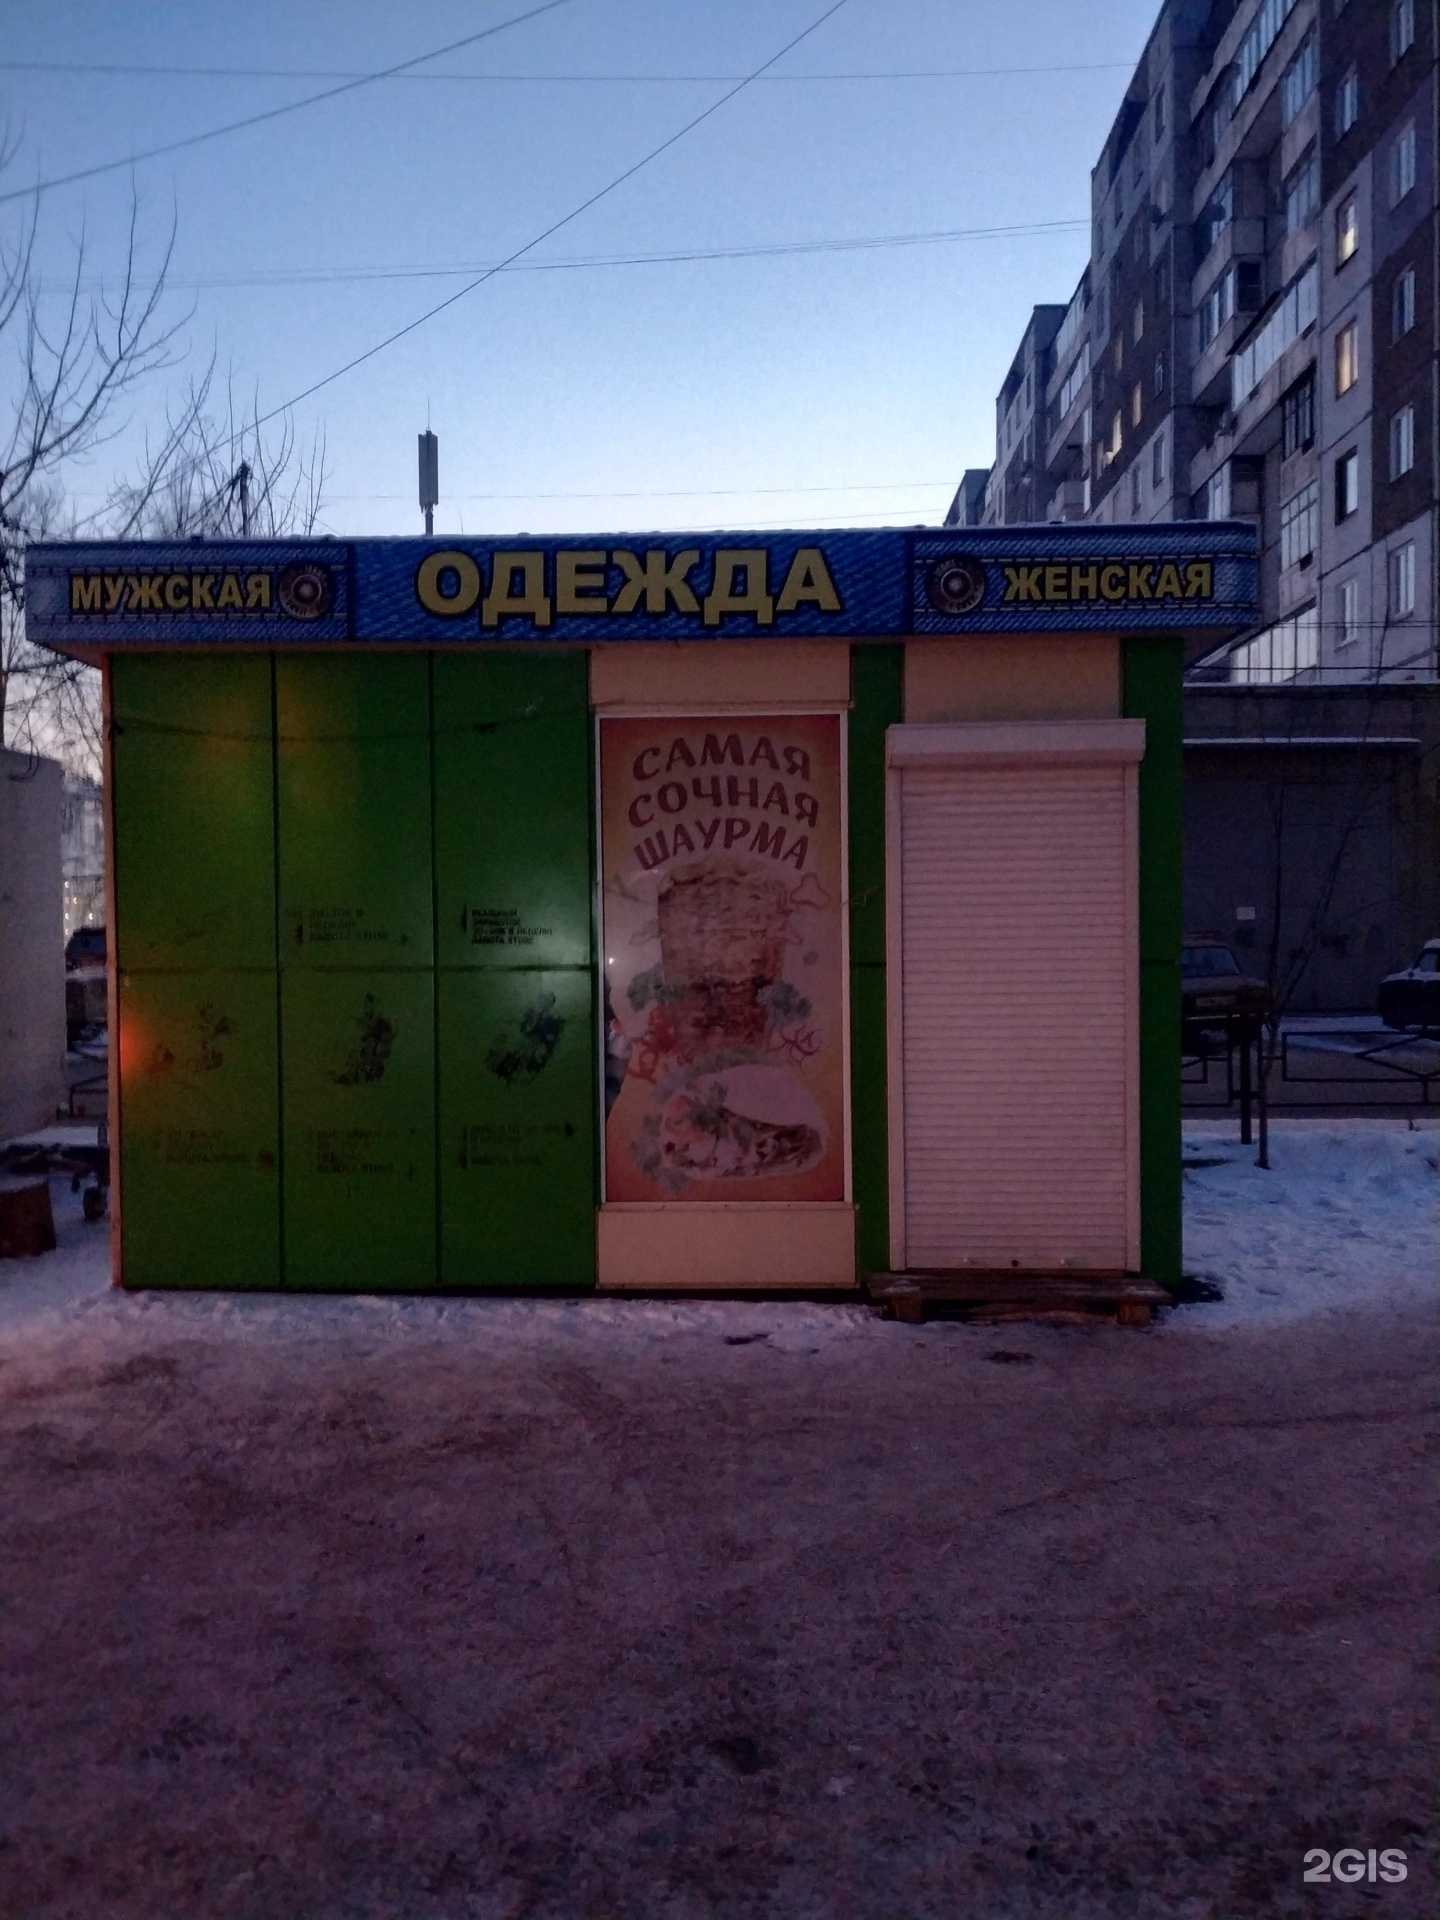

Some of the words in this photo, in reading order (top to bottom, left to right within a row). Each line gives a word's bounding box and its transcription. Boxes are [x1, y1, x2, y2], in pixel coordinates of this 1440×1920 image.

[70, 574, 271, 611] МУЖСКАЯ
[416, 551, 841, 627] ОДЕЖДА
[1002, 562, 1213, 603] ЖЕНСКАЯ
[633, 733, 811, 781] САМАЯ
[628, 775, 820, 828] СОЧНАЯ
[632, 817, 809, 870] ШАУРМА
